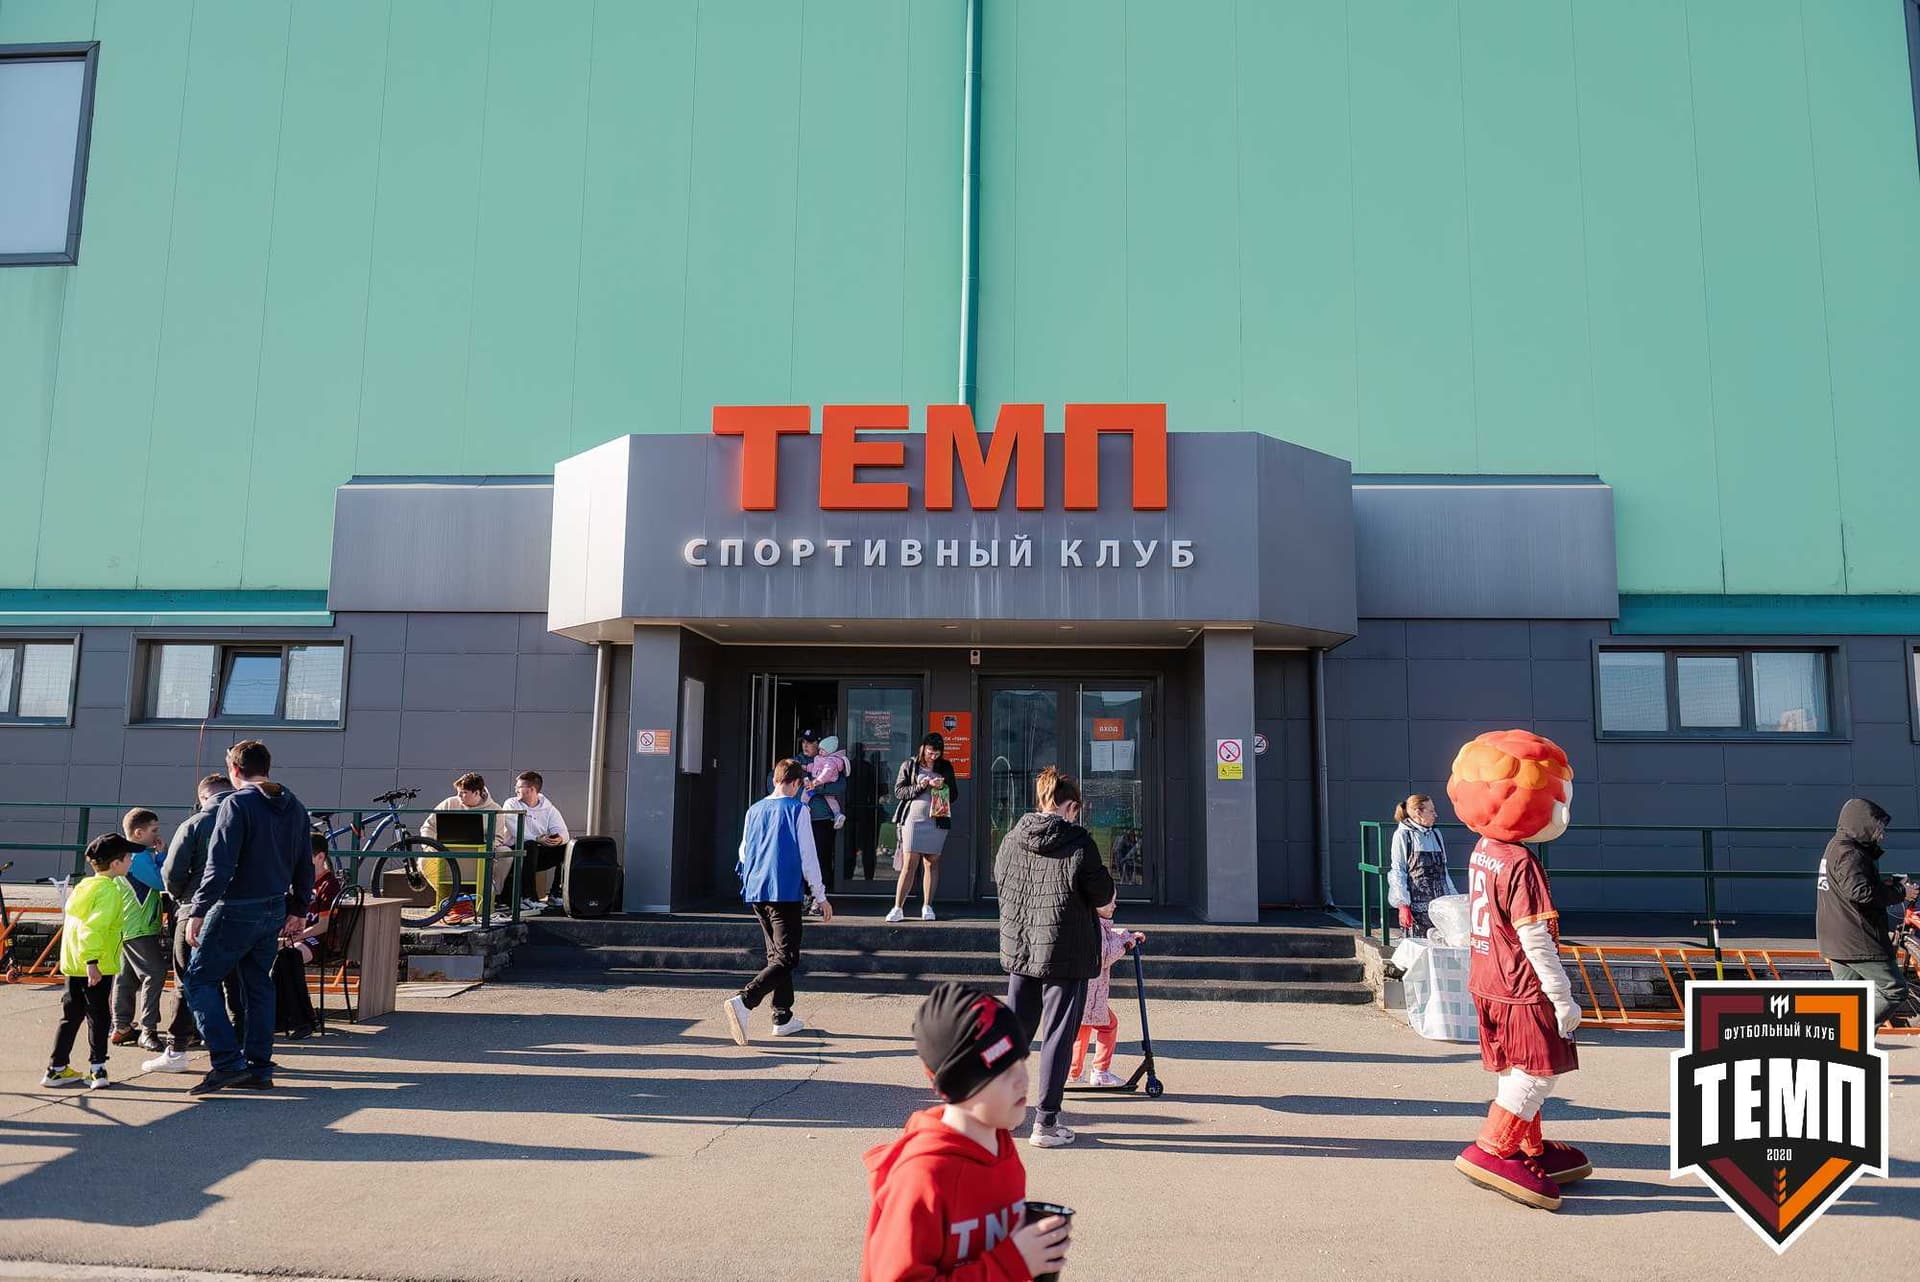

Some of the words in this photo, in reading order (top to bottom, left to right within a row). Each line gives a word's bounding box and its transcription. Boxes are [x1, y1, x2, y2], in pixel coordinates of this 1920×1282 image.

[713, 404, 1167, 510] ТЕМП
[683, 534, 1032, 568] СПОРТИВНЫЙ
[1061, 539, 1196, 569] КЛУБ
